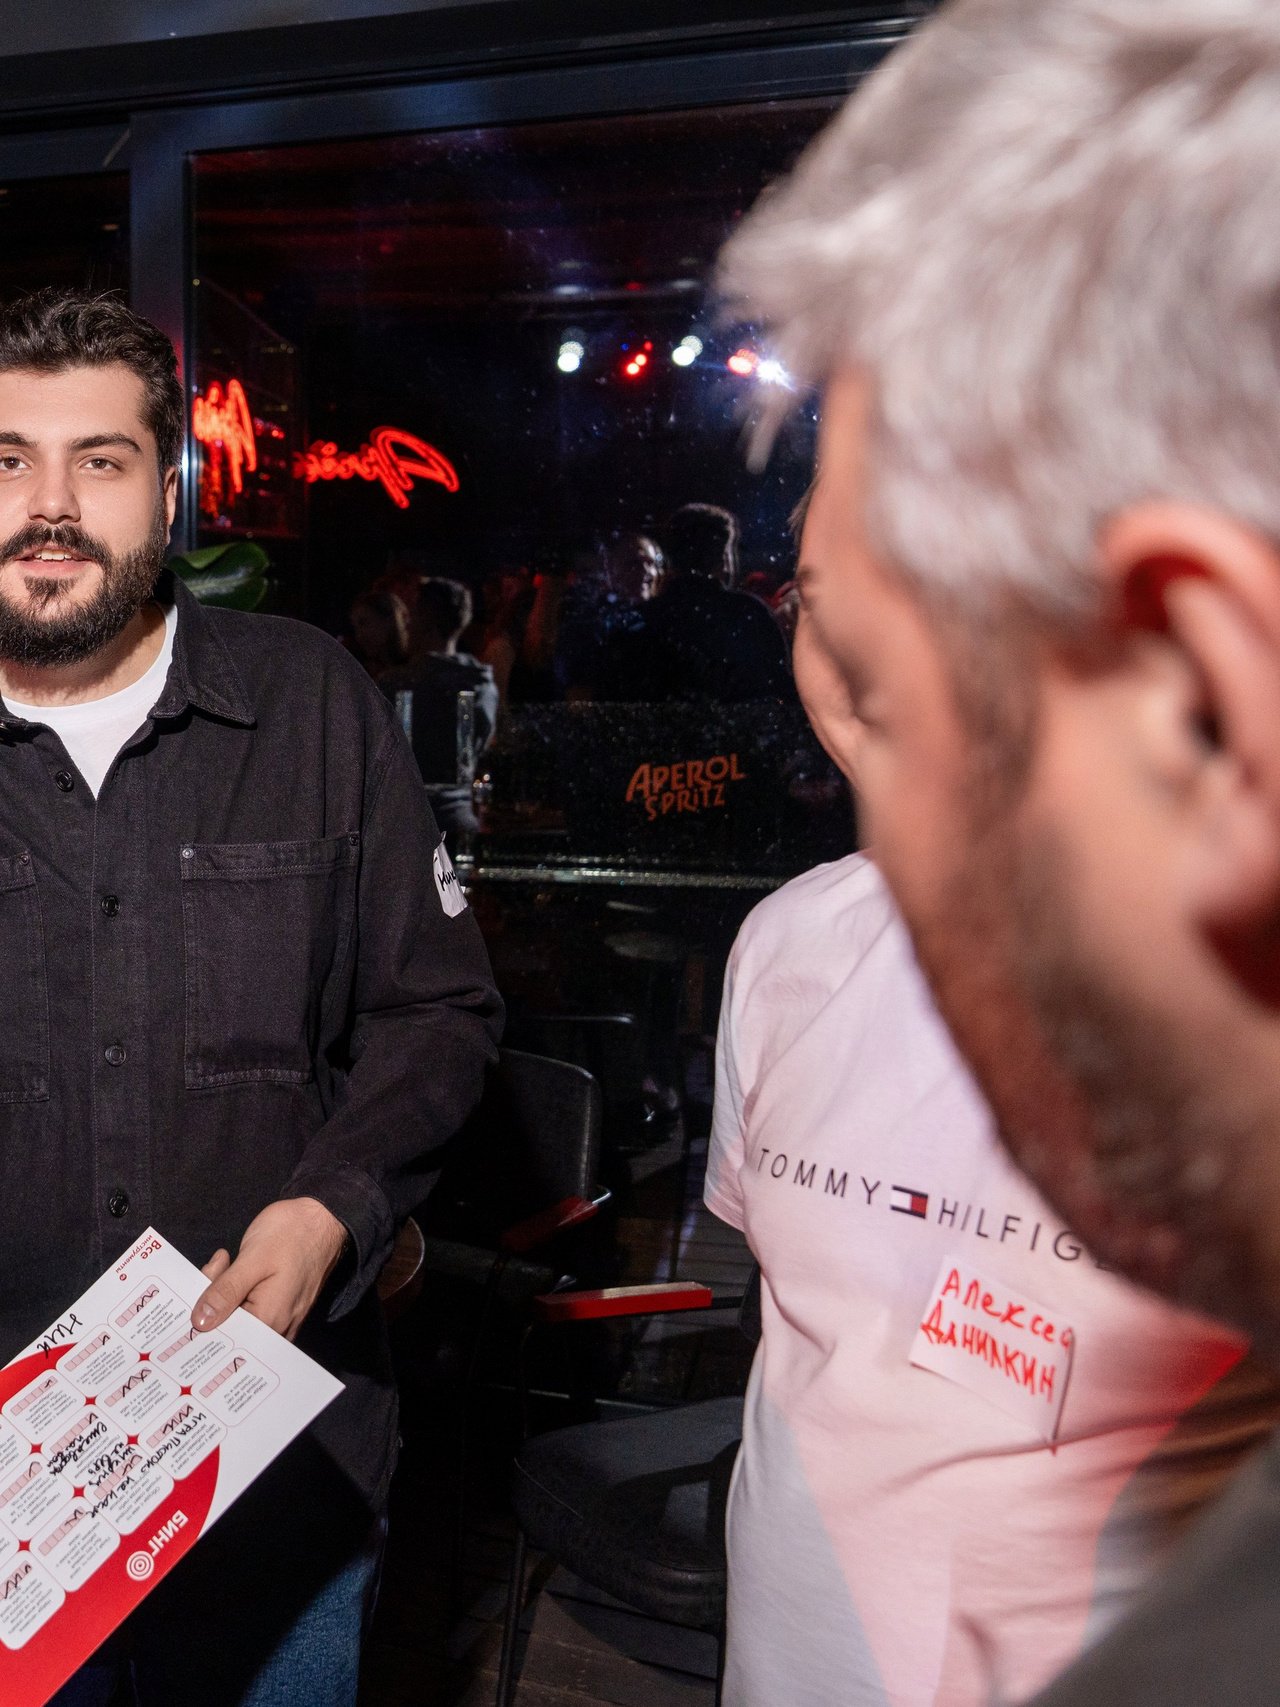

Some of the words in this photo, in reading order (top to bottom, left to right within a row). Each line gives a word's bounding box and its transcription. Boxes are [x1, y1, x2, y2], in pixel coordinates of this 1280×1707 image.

[625, 753, 746, 802] APEROL
[757, 1147, 881, 1205] TOMMY
[140, 1239, 163, 1260] Все
